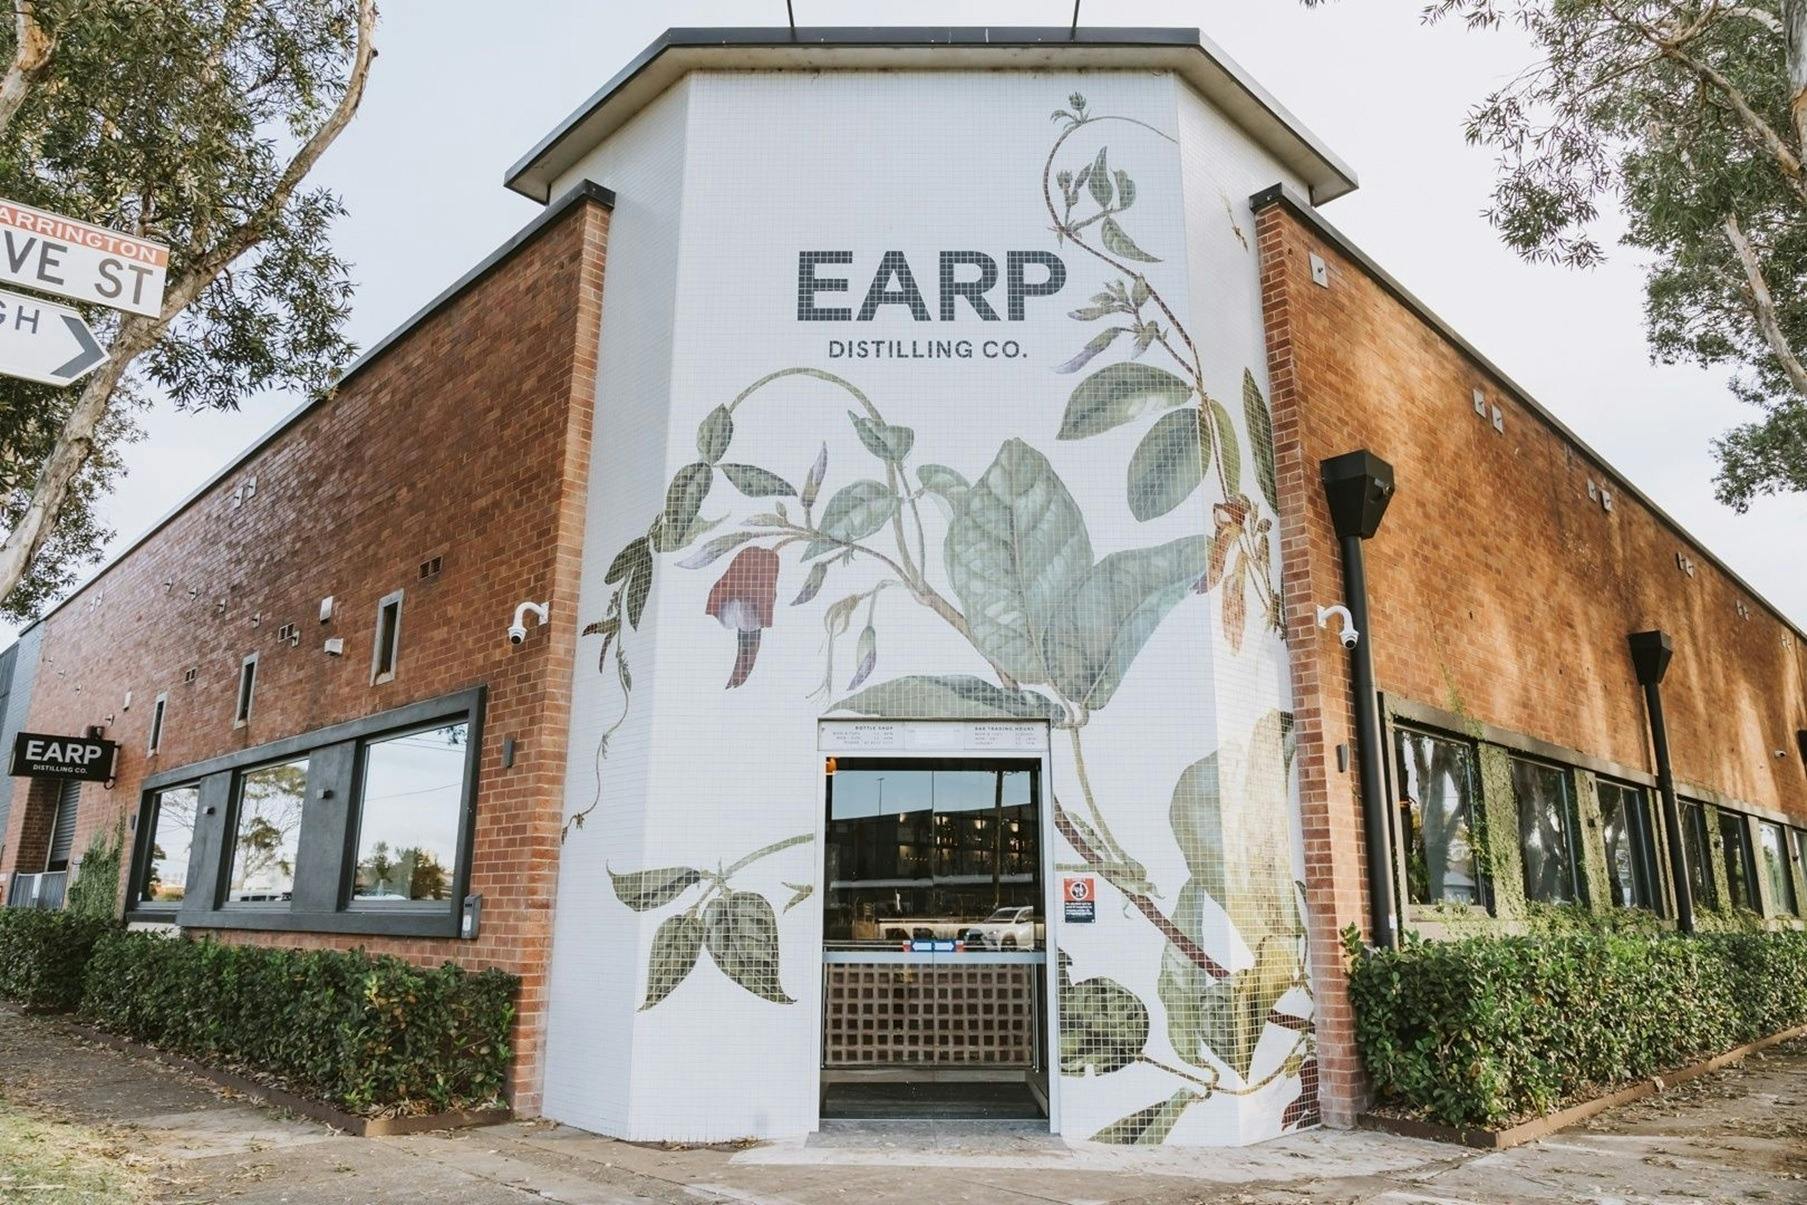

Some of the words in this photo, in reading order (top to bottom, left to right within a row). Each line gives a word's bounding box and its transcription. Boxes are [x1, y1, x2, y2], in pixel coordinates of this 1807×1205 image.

[94, 257, 154, 305] ST
[797, 250, 1067, 322] EARP
[829, 340, 973, 359] DISTILLING
[982, 340, 1028, 359] CO.
[25, 740, 102, 765] EARP
[33, 764, 74, 774] DISTILLING
